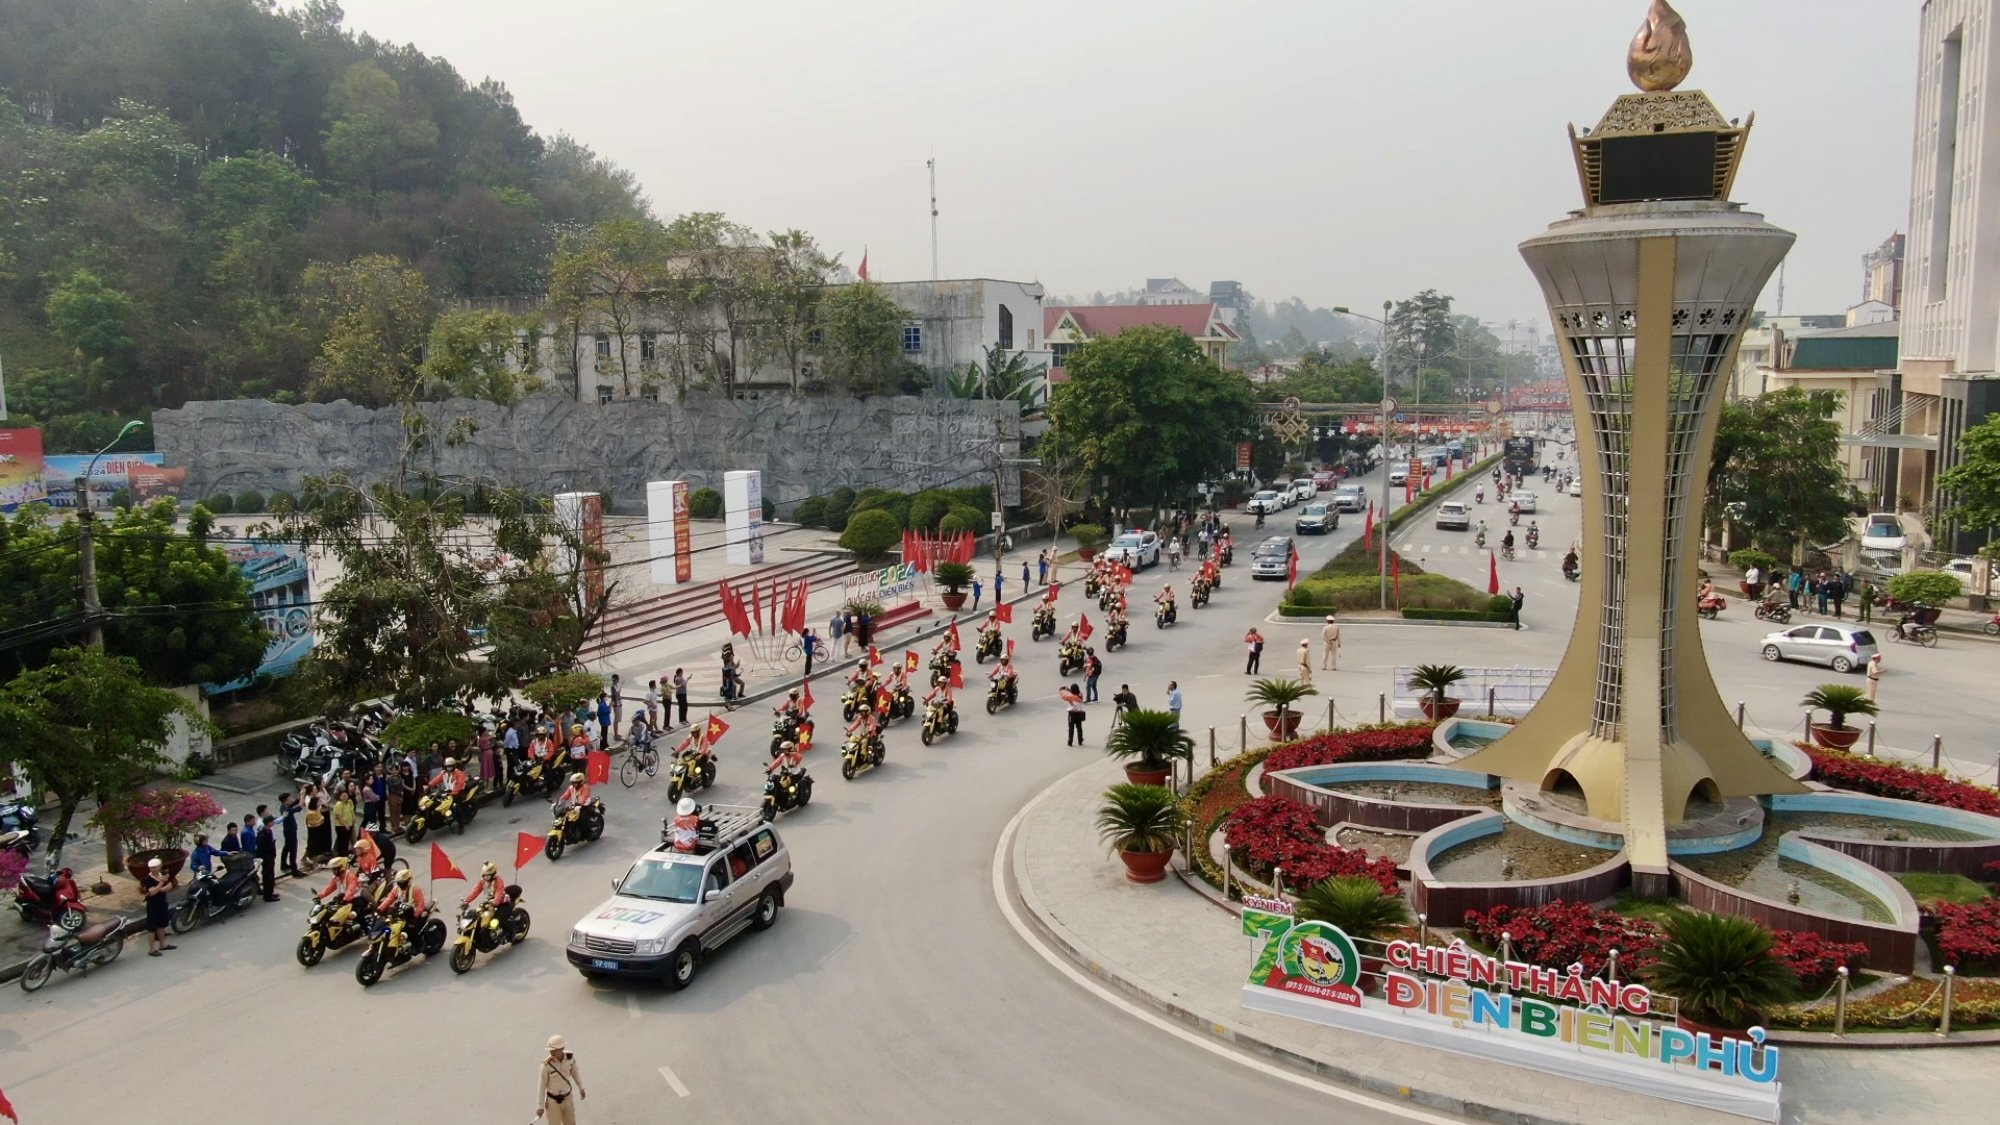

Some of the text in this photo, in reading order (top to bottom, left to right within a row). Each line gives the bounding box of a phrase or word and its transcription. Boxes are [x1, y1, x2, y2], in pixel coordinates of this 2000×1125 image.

[879, 560, 916, 587] 2024
[1386, 938, 1496, 985] CHIẾN
[1504, 960, 1650, 1015] THẮNG
[1383, 971, 1512, 1029] ĐIỆN
[1520, 997, 1652, 1059] BIÊN
[1659, 1025, 1779, 1084] PHỦ
